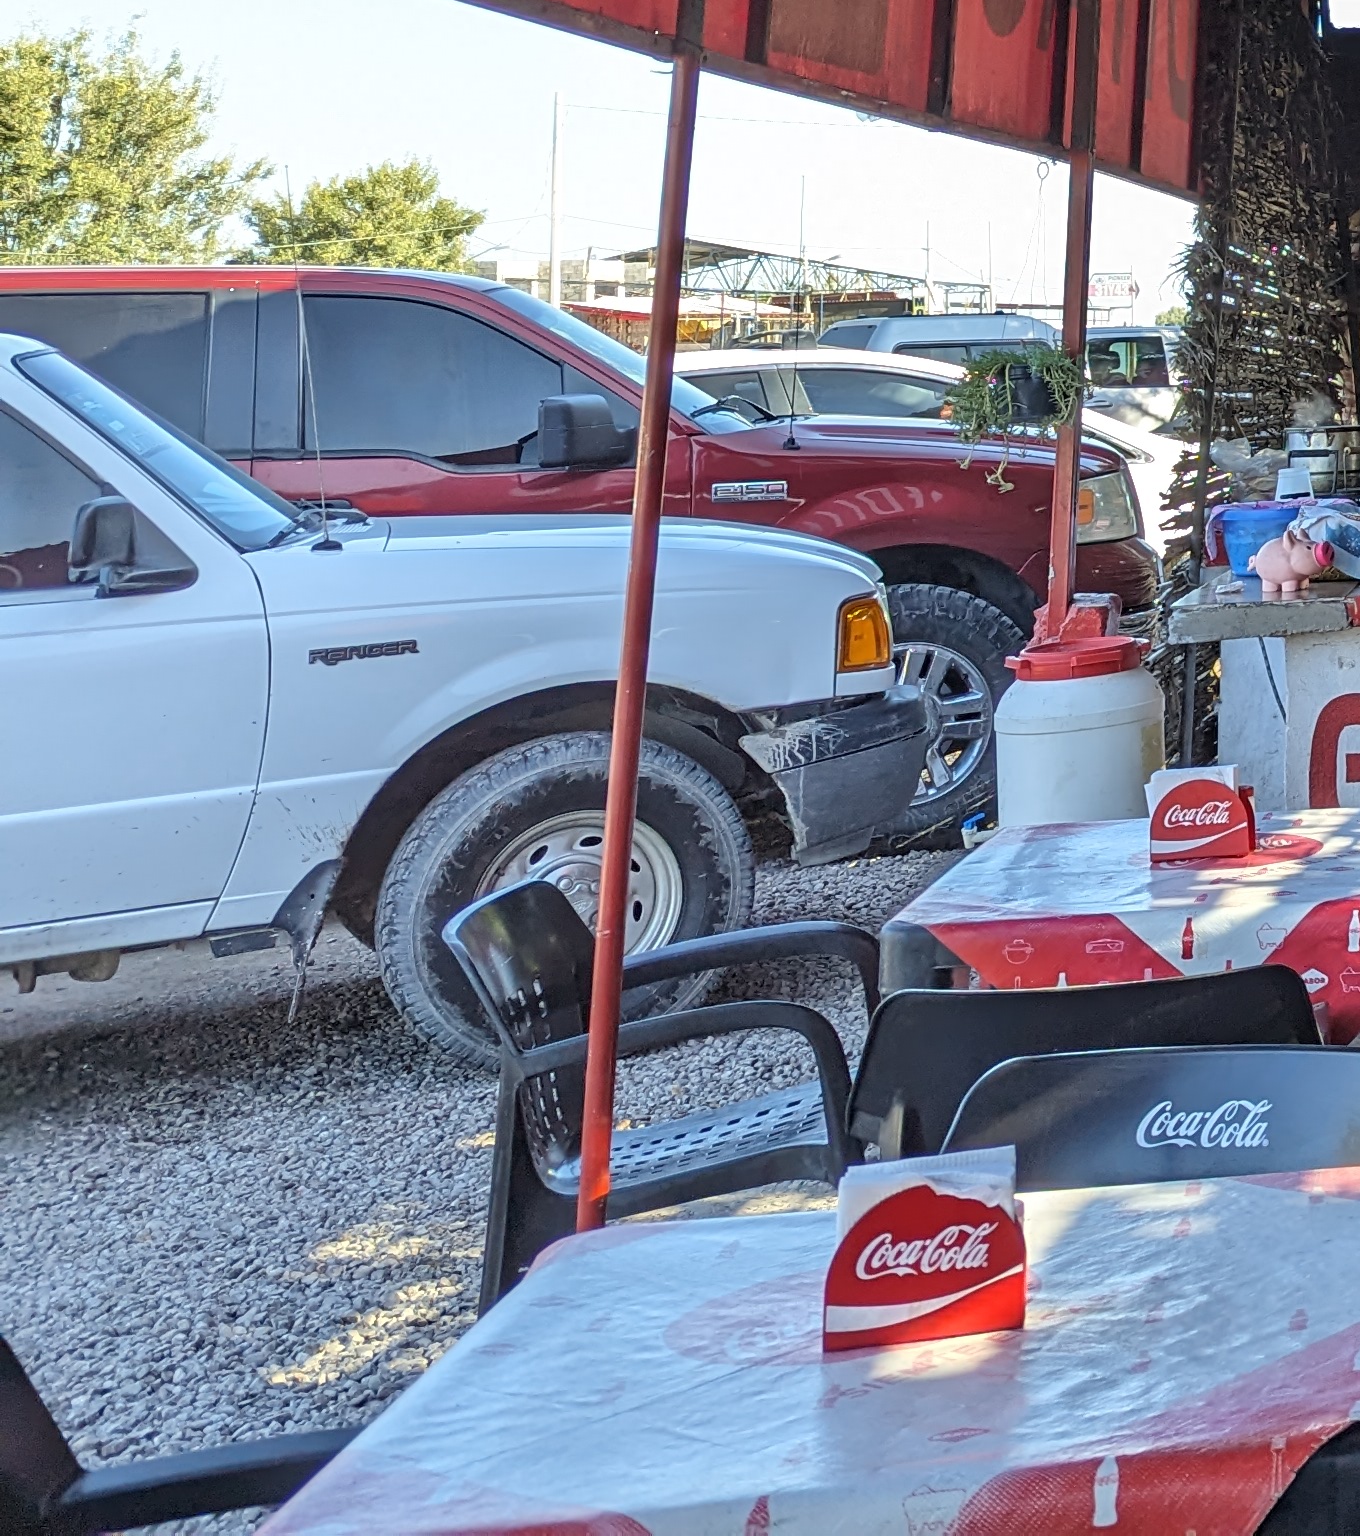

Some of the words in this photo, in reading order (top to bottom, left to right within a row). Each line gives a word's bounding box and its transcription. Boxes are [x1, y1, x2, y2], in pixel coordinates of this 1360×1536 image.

[308, 639, 420, 666] RANGER
[1164, 800, 1233, 828] Coca-Cola
[1136, 1099, 1273, 1148] Coca-Cola
[856, 1221, 999, 1280] Coca-Cola
